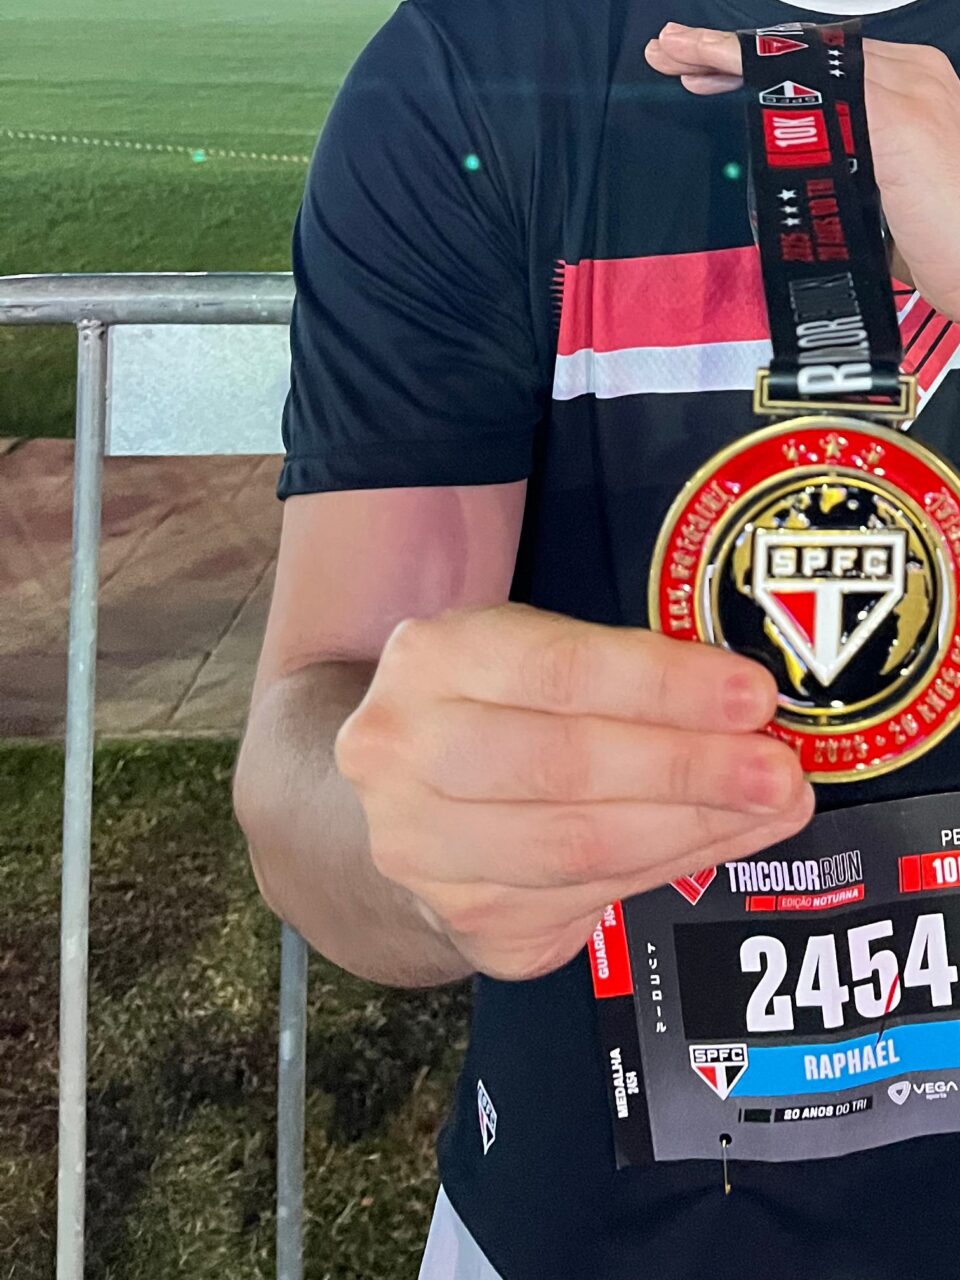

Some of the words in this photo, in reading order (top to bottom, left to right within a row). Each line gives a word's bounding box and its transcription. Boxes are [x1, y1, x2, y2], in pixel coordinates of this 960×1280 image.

[773, 116, 818, 147] 10K
[771, 549, 890, 576] SPFC
[781, 896, 812, 910] EDIÇÃO
[812, 887, 860, 908] NOTURNA
[739, 912, 959, 1032] 2454
[694, 1048, 744, 1063] SPFC
[804, 1038, 900, 1081] RAPHAEL
[609, 1047, 629, 1119] MEDALHA
[912, 1080, 959, 1095] VEGA
[801, 1105, 834, 1119] ANOS
[836, 1102, 850, 1116] DO
[851, 1098, 867, 1113] TRI
